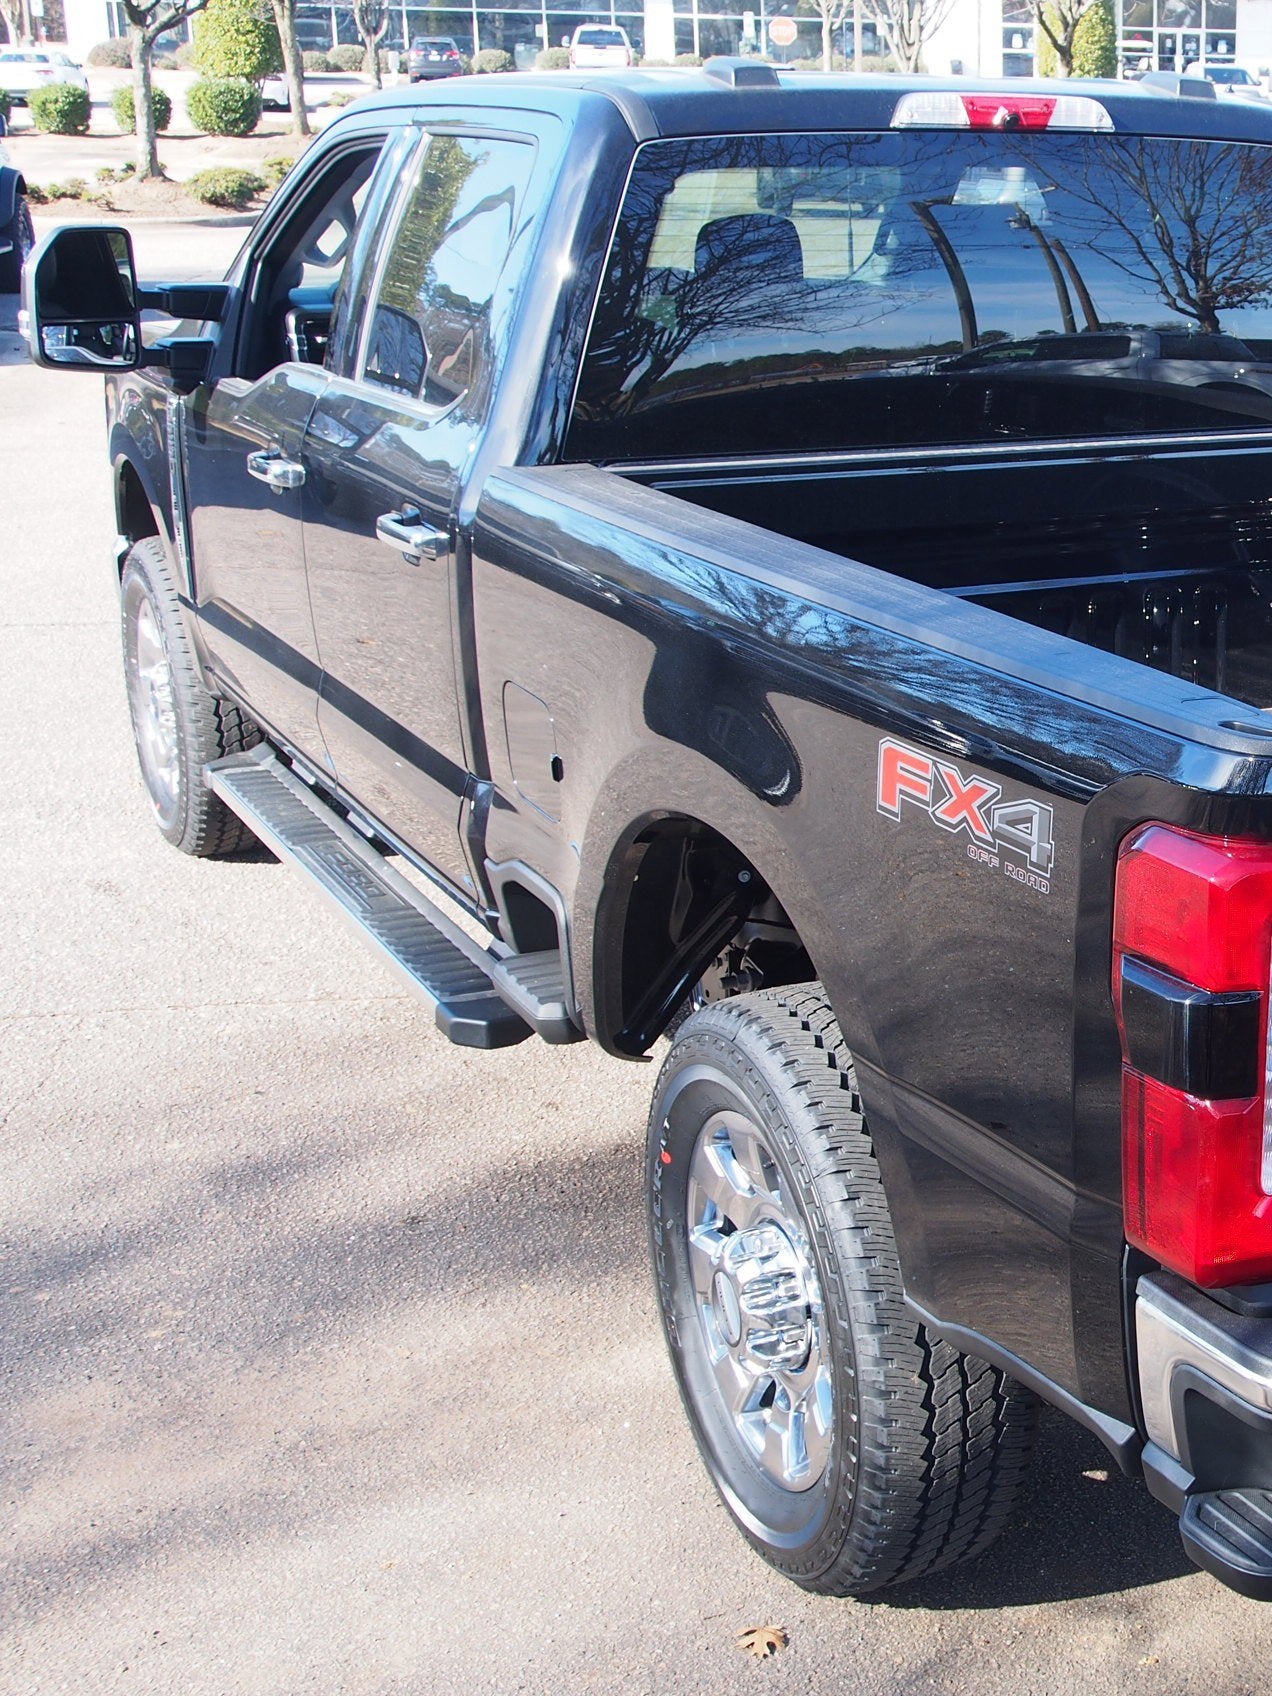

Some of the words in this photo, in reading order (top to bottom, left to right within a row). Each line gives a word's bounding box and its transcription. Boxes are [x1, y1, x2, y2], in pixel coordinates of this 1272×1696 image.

[876, 736, 1055, 879] FX4
[966, 844, 999, 868] OFF
[1004, 861, 1050, 895] ROAD
